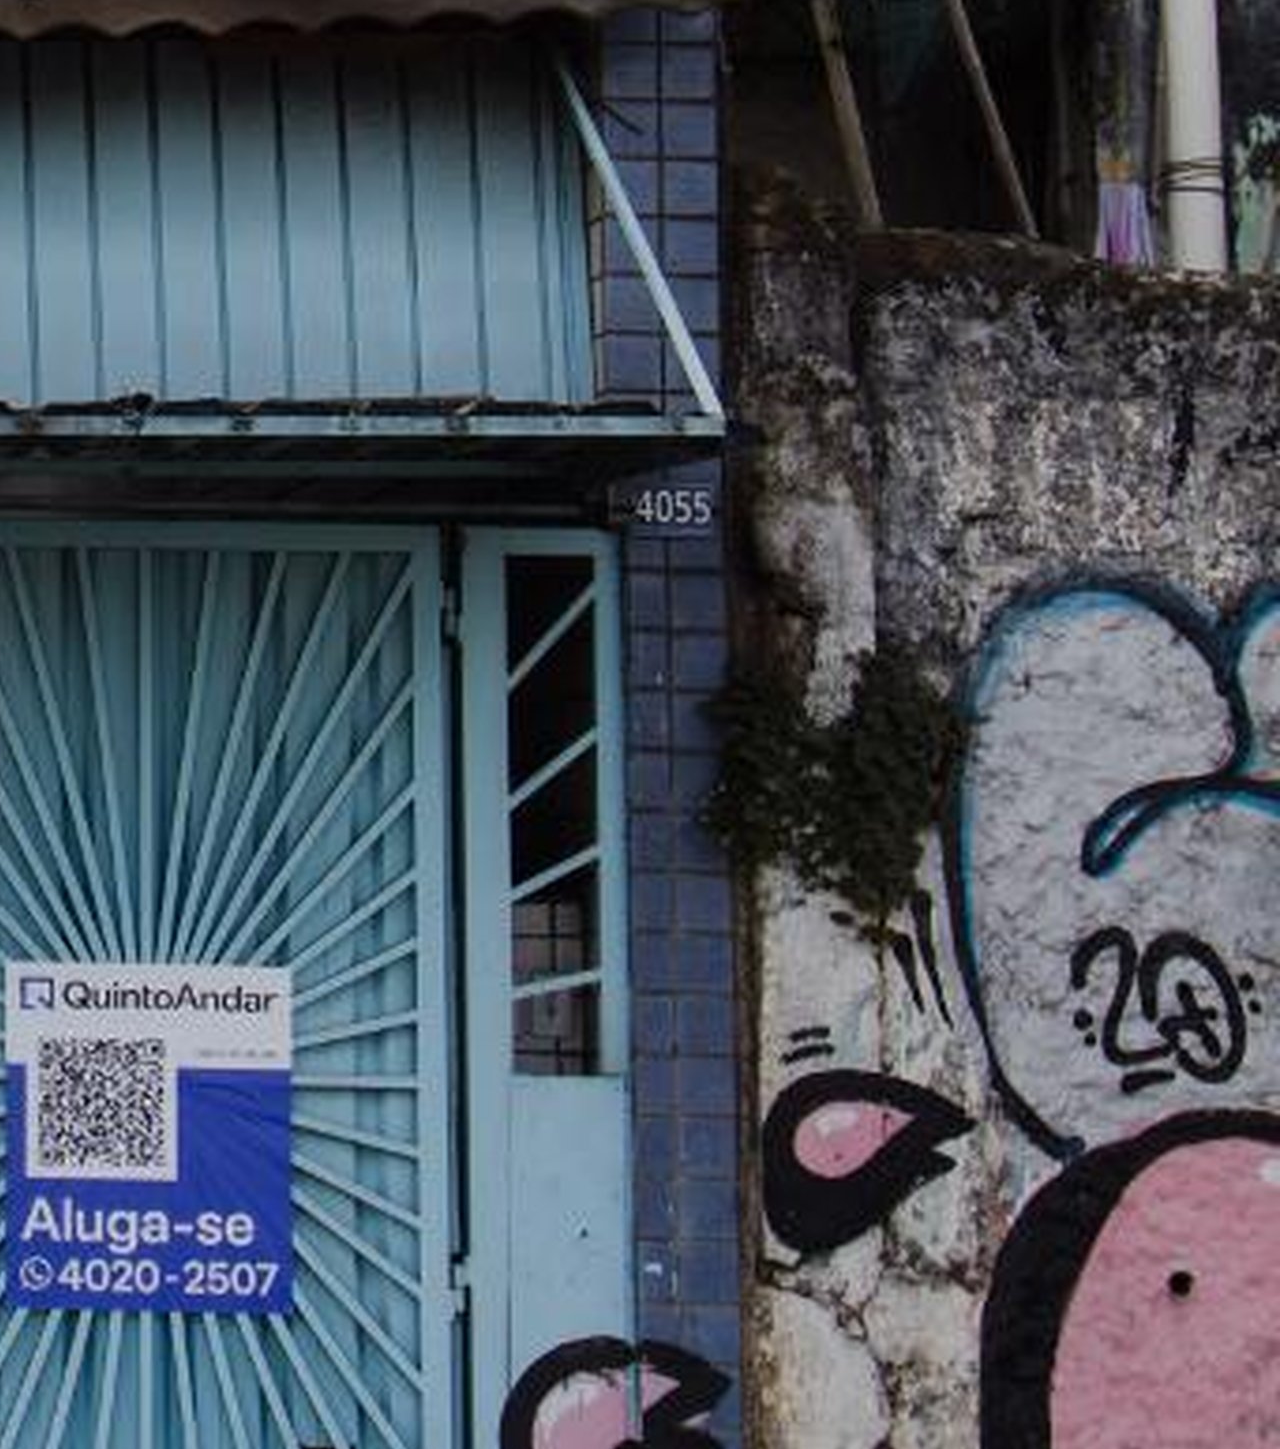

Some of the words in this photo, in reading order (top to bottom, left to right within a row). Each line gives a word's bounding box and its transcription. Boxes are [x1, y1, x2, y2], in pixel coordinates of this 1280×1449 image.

[634, 489, 713, 525] 4055
[62, 981, 280, 1014] QuintoAndar
[20, 1196, 255, 1255] Aluga-se
